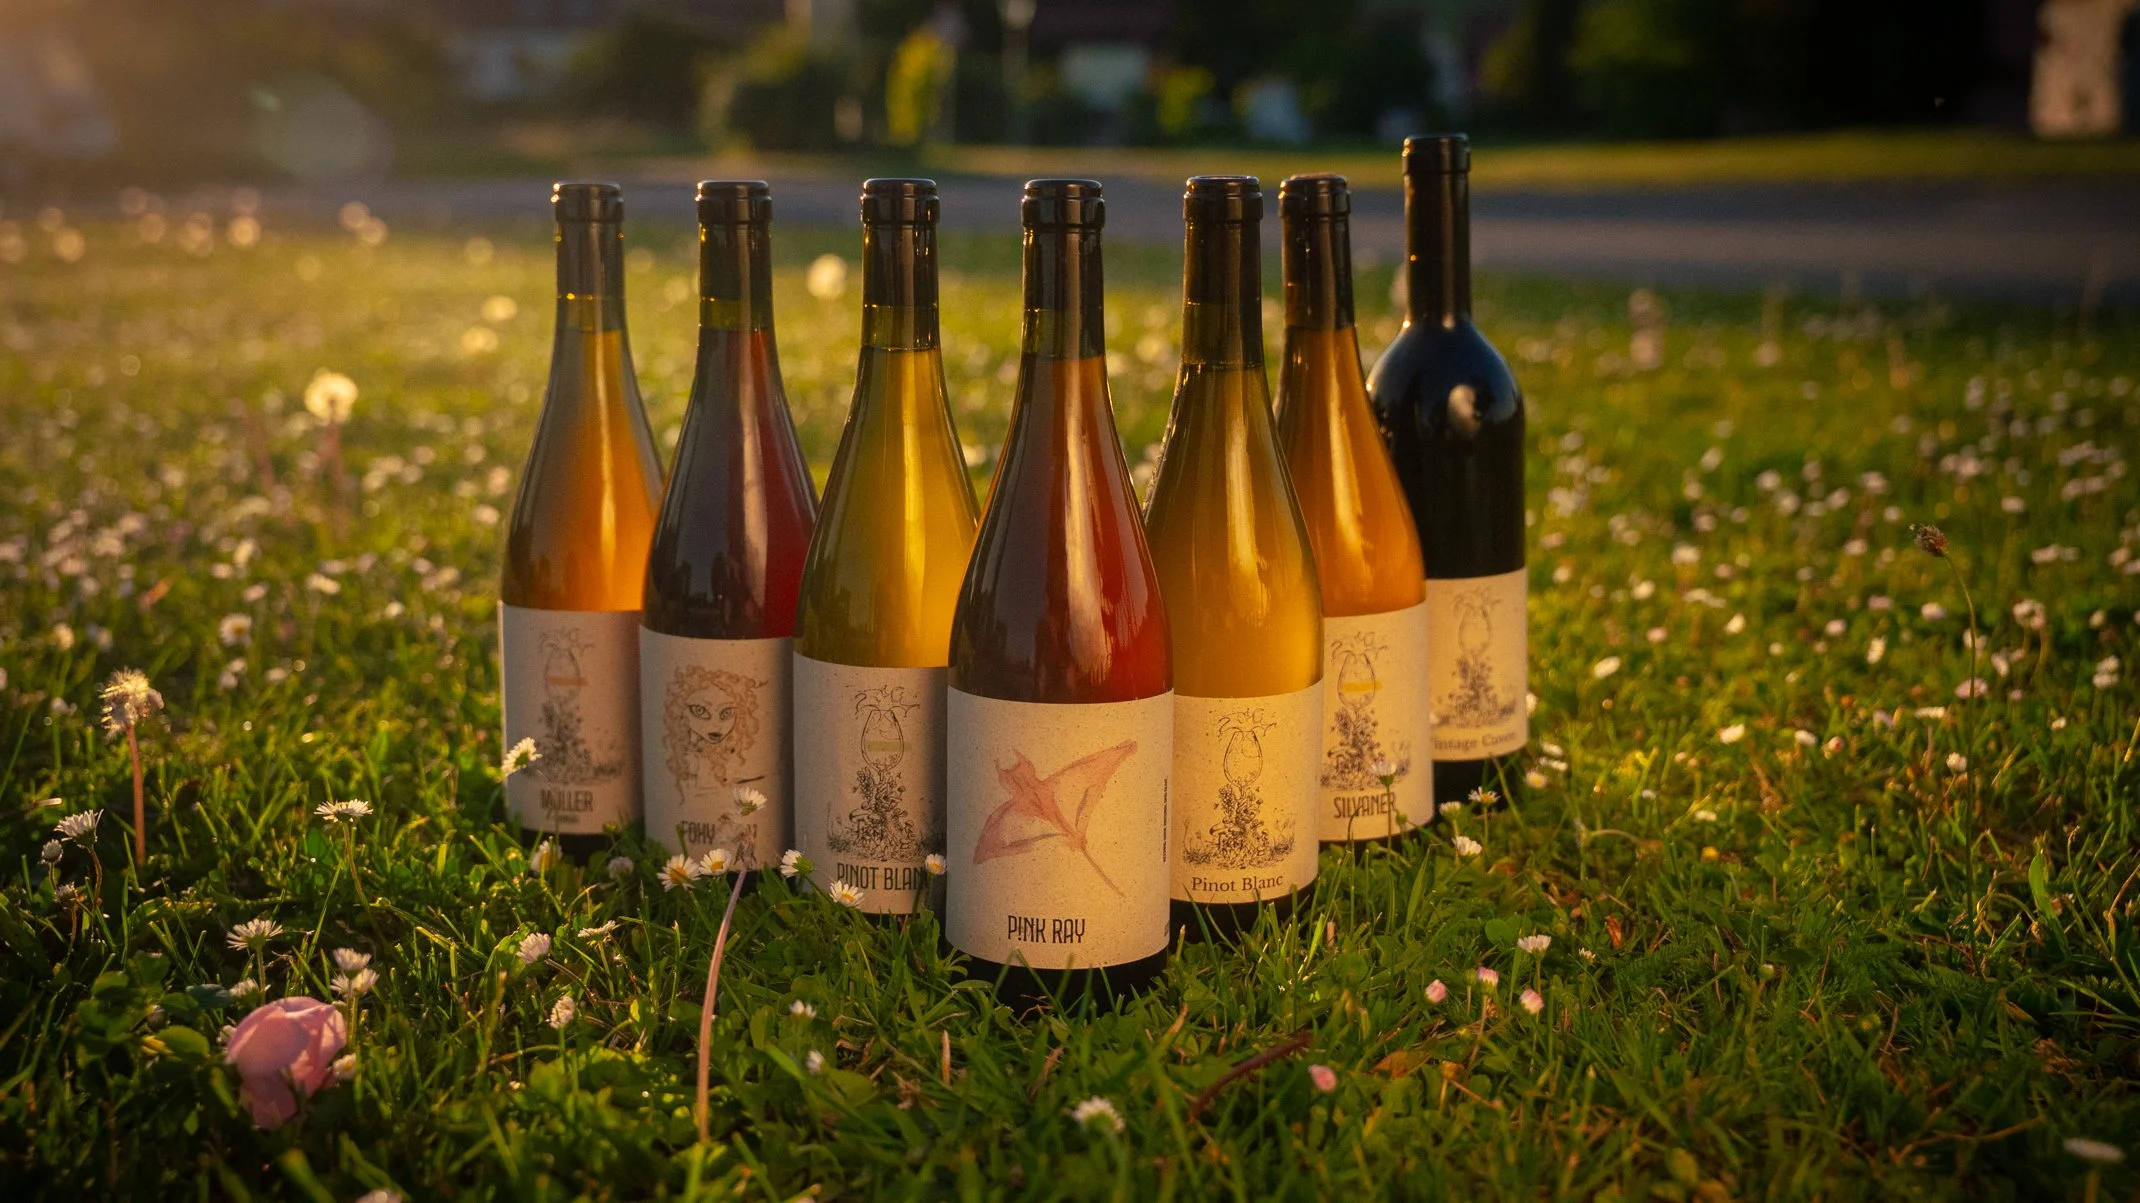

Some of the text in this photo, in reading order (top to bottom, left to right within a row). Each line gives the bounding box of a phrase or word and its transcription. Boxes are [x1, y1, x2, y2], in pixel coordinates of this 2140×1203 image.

[1333, 792, 1396, 818] SILVANER
[837, 862, 879, 890] PINOT
[1191, 875, 1283, 892] Pinot Blanc
[1052, 918, 1086, 943] RAY
